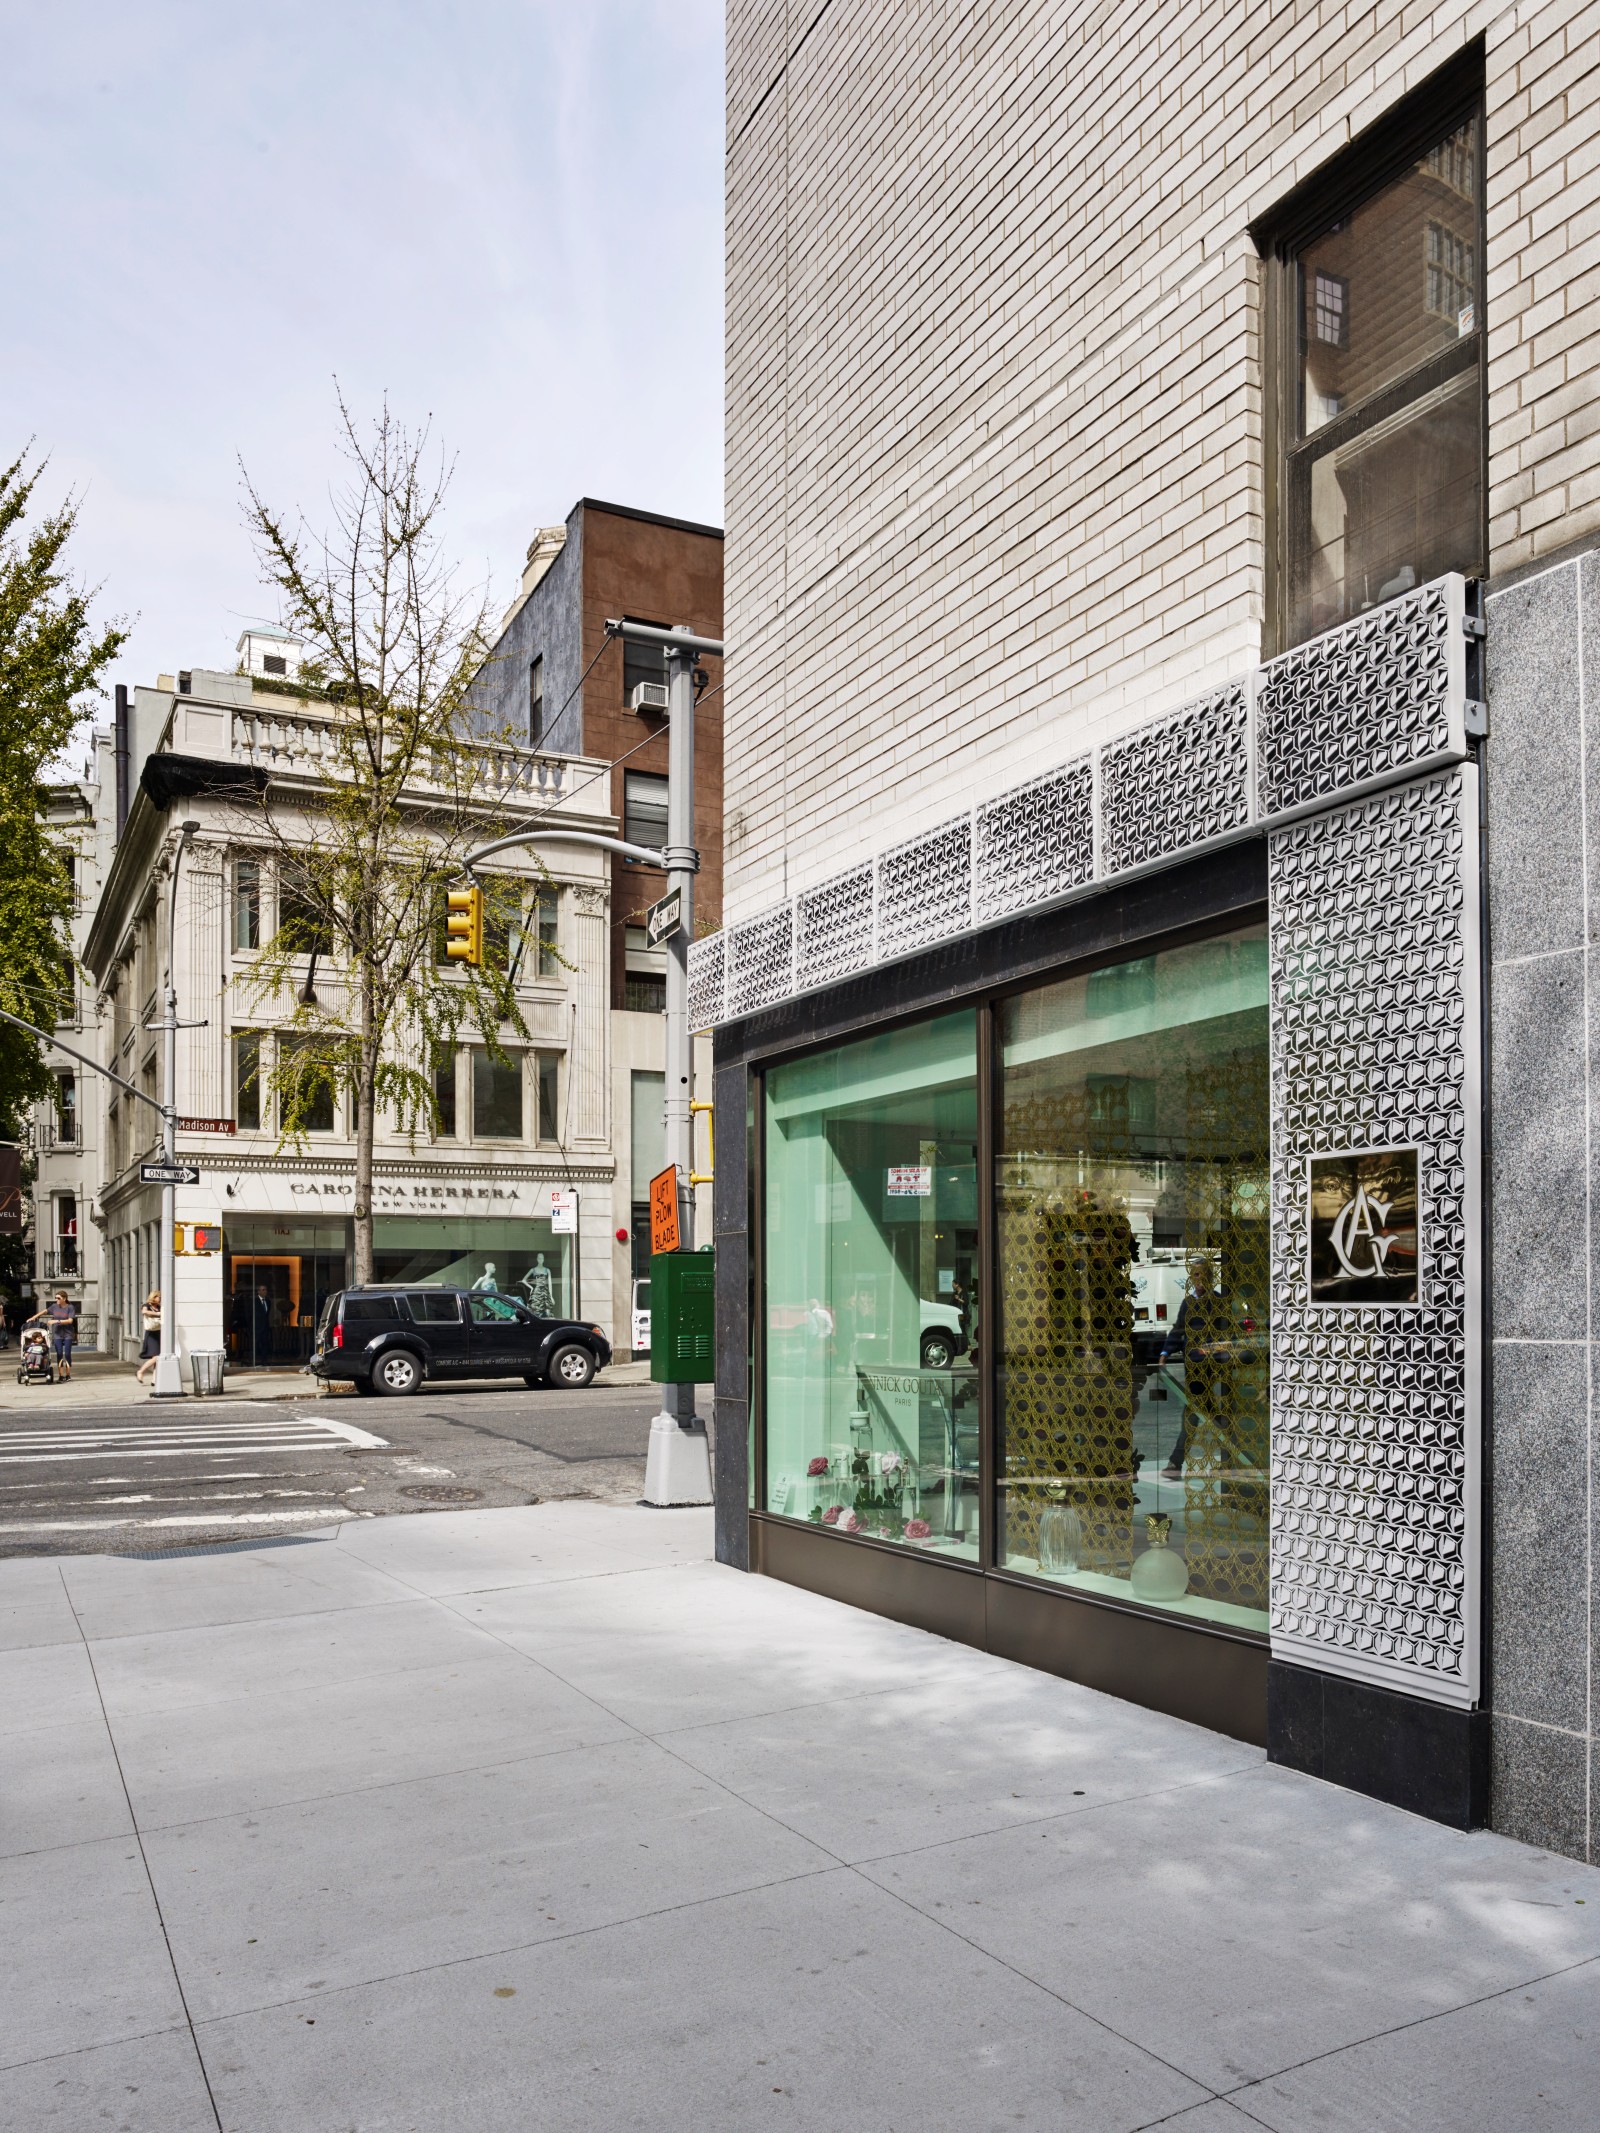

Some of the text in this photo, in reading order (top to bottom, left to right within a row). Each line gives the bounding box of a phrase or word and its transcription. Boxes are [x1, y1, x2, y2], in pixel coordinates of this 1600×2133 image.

[653, 901, 678, 932] ONE WAY
[179, 1120, 229, 1132] Madison Av
[149, 1169, 191, 1179] ONE WAY
[291, 1183, 521, 1200] CAROINA HERRERA
[656, 1180, 669, 1202] LIFT
[409, 1202, 448, 1210] YORK
[656, 1201, 672, 1226] PLOW
[655, 1225, 676, 1250] BLADE
[895, 1398, 912, 1407] PARIS
